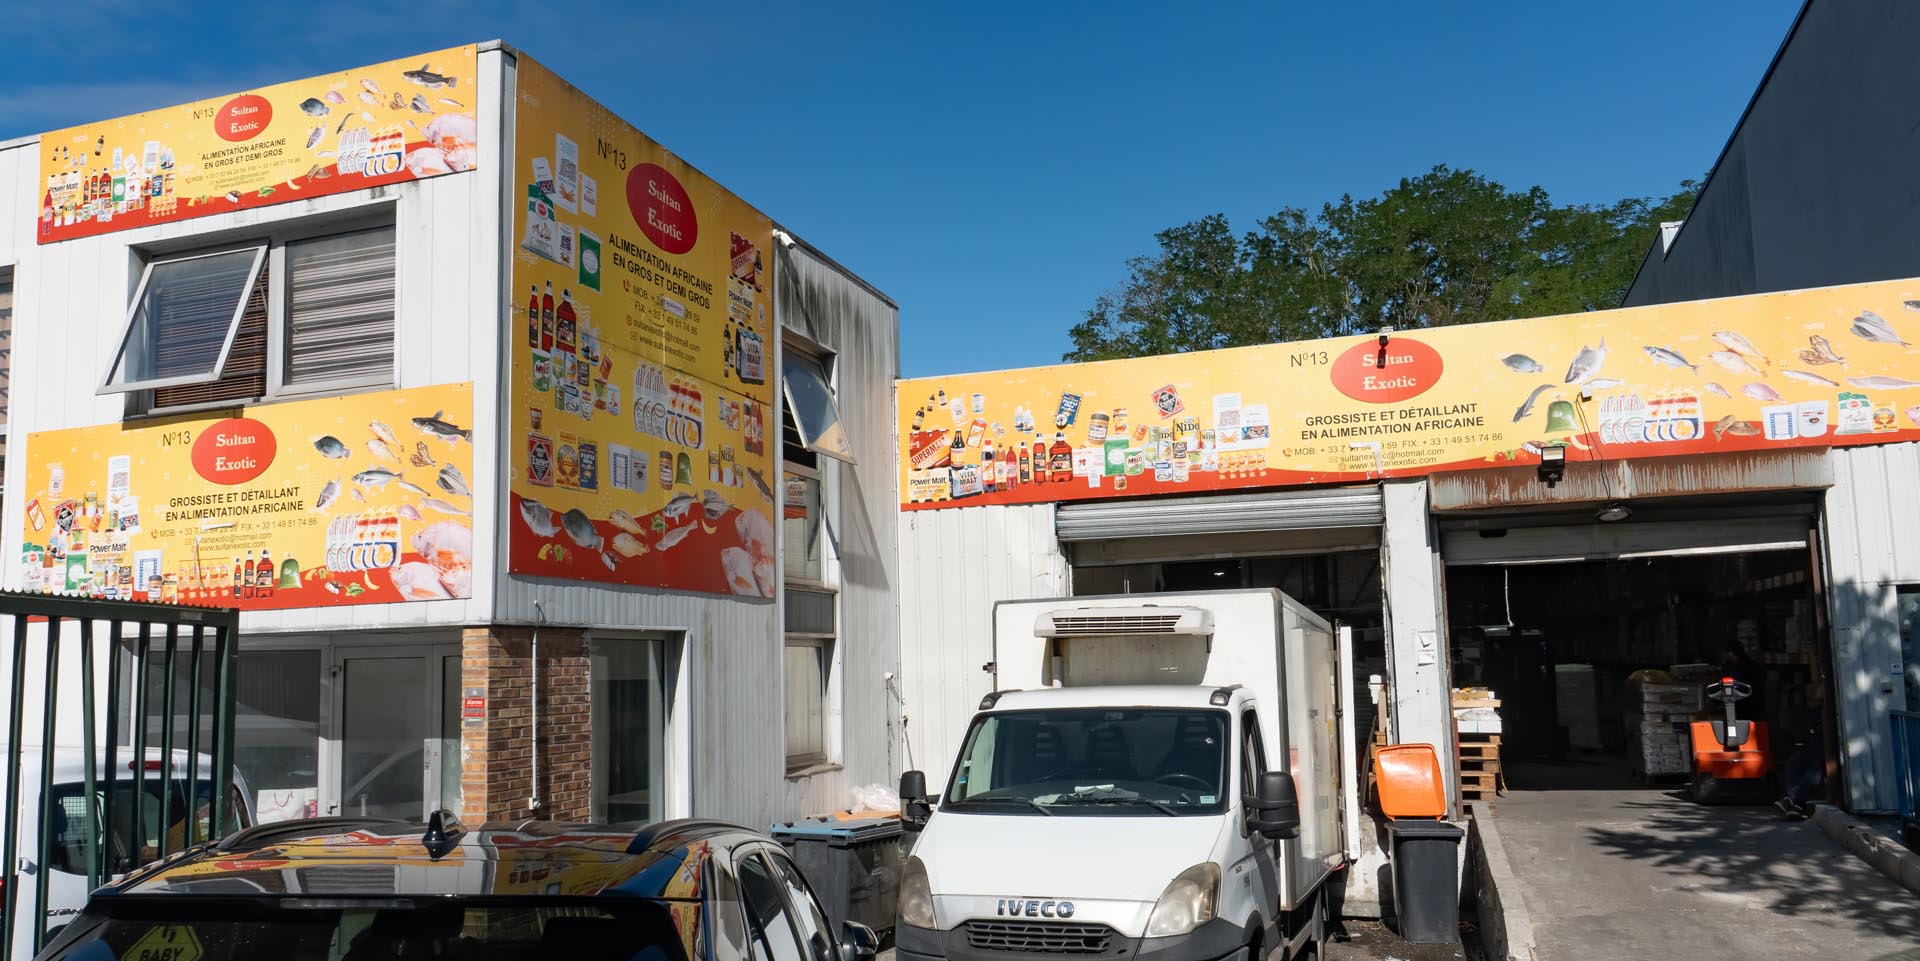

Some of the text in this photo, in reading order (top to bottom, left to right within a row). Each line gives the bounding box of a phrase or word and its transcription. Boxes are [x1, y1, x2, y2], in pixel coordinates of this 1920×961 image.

[231, 106, 258, 117] Sultan
[231, 121, 259, 133] Exotic
[202, 138, 286, 161] ALIMENTATION AFRICAINE
[204, 148, 283, 169] EN GROS ET DEMI GROS
[648, 180, 681, 212] Sultan
[648, 207, 682, 240] Exotic
[609, 234, 713, 296] ALIMENTATION AFRICAINE
[613, 252, 626, 268] EN
[628, 260, 652, 282] GROS
[654, 274, 664, 288] ET
[666, 280, 686, 298] DEMI
[688, 290, 710, 309] GROS
[1363, 376, 1417, 390] Exotic
[1305, 403, 1478, 426] GROSSISTE ET DÉTAILLANT
[1301, 416, 1484, 440] EN ALIMENTATION AFRICAINE
[216, 434, 256, 446] Sultan
[1328, 446, 1338, 454] 33
[1386, 441, 1398, 450] 59
[1430, 438, 1440, 446] 33
[1452, 436, 1462, 444] 49
[1465, 435, 1475, 443] 51
[1478, 434, 1489, 442] 74
[1492, 433, 1503, 441] 86
[216, 457, 256, 472] Exotic
[910, 478, 931, 486] Power
[960, 477, 977, 486] MALT
[170, 487, 300, 507] GROSSISTE ET DÉTAILLANT
[166, 500, 304, 522] EN ALIMENTATION AFRICAINE
[184, 526, 192, 535] 33
[262, 522, 270, 530] 33
[278, 520, 286, 528] 49
[288, 520, 296, 528] 51
[297, 518, 306, 526] 74
[308, 517, 318, 526] 86
[90, 543, 126, 553] Power Malt
[997, 900, 1075, 918] IVECO
[140, 946, 185, 961] BABY
